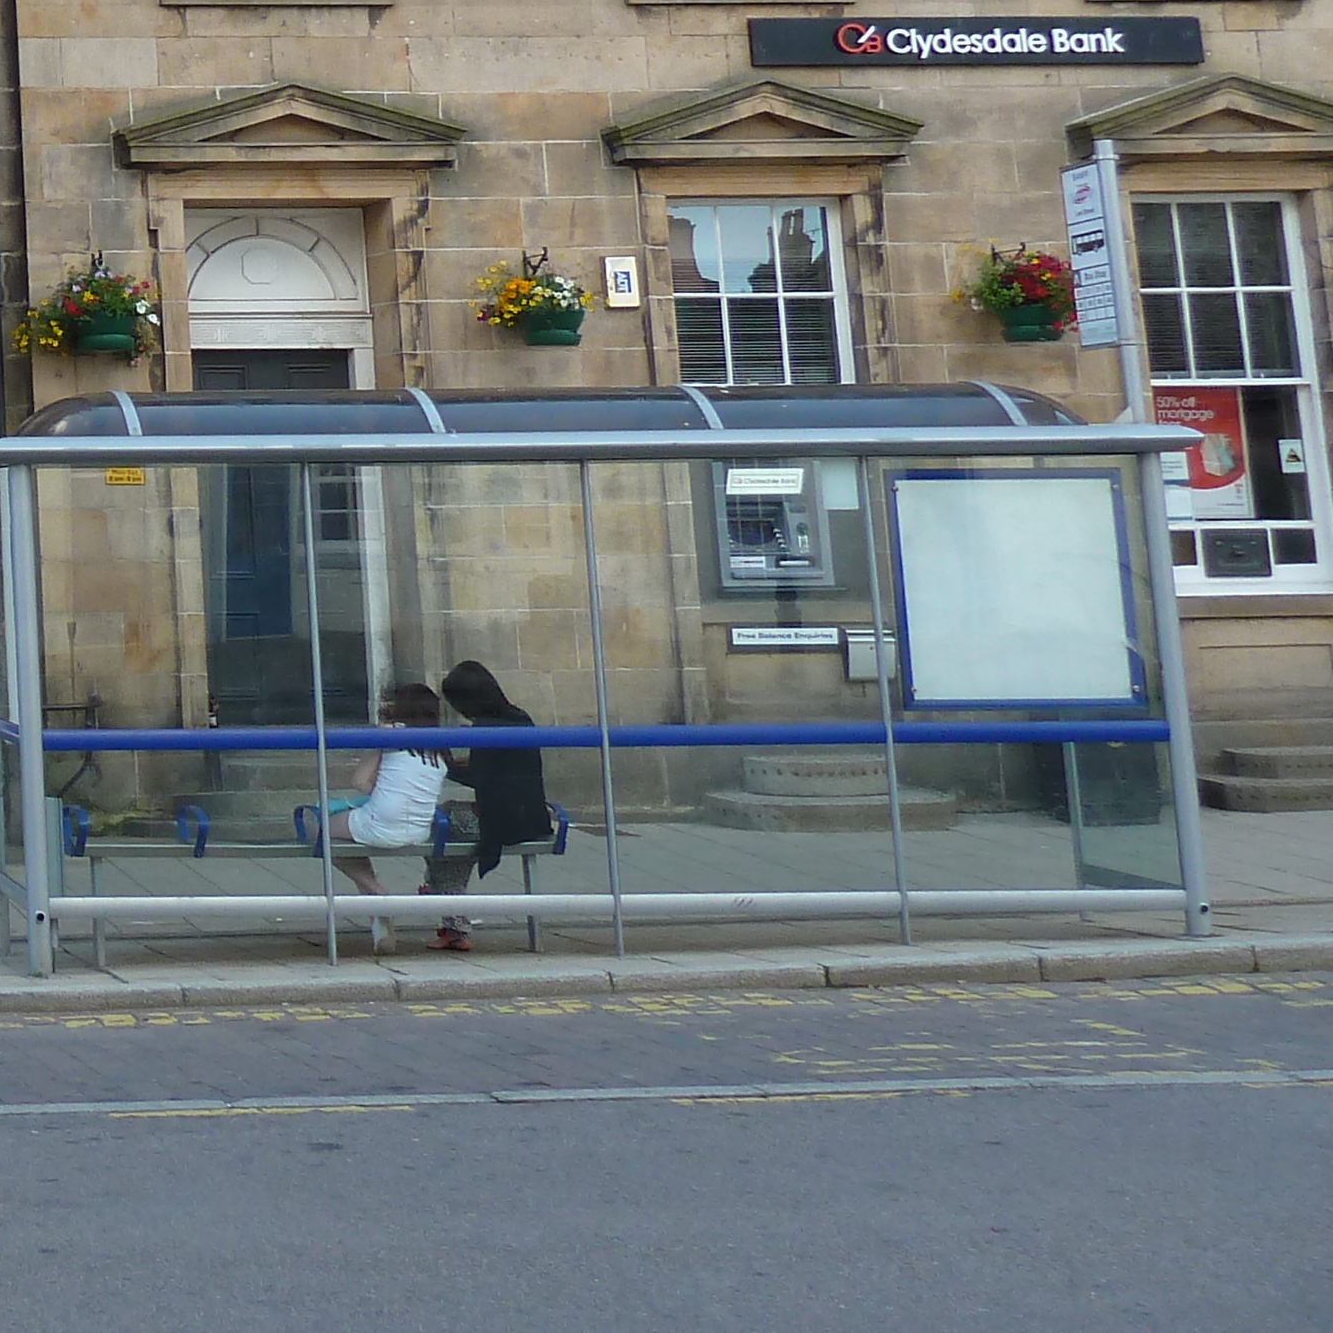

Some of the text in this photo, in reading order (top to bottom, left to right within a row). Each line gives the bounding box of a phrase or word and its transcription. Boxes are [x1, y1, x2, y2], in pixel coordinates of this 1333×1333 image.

[886, 27, 1047, 59] Clydesdale
[1050, 27, 1126, 53] Bank
[1155, 396, 1196, 408] 50% off
[1157, 409, 1215, 421] mortgage
[794, 632, 833, 640] Enquiries
